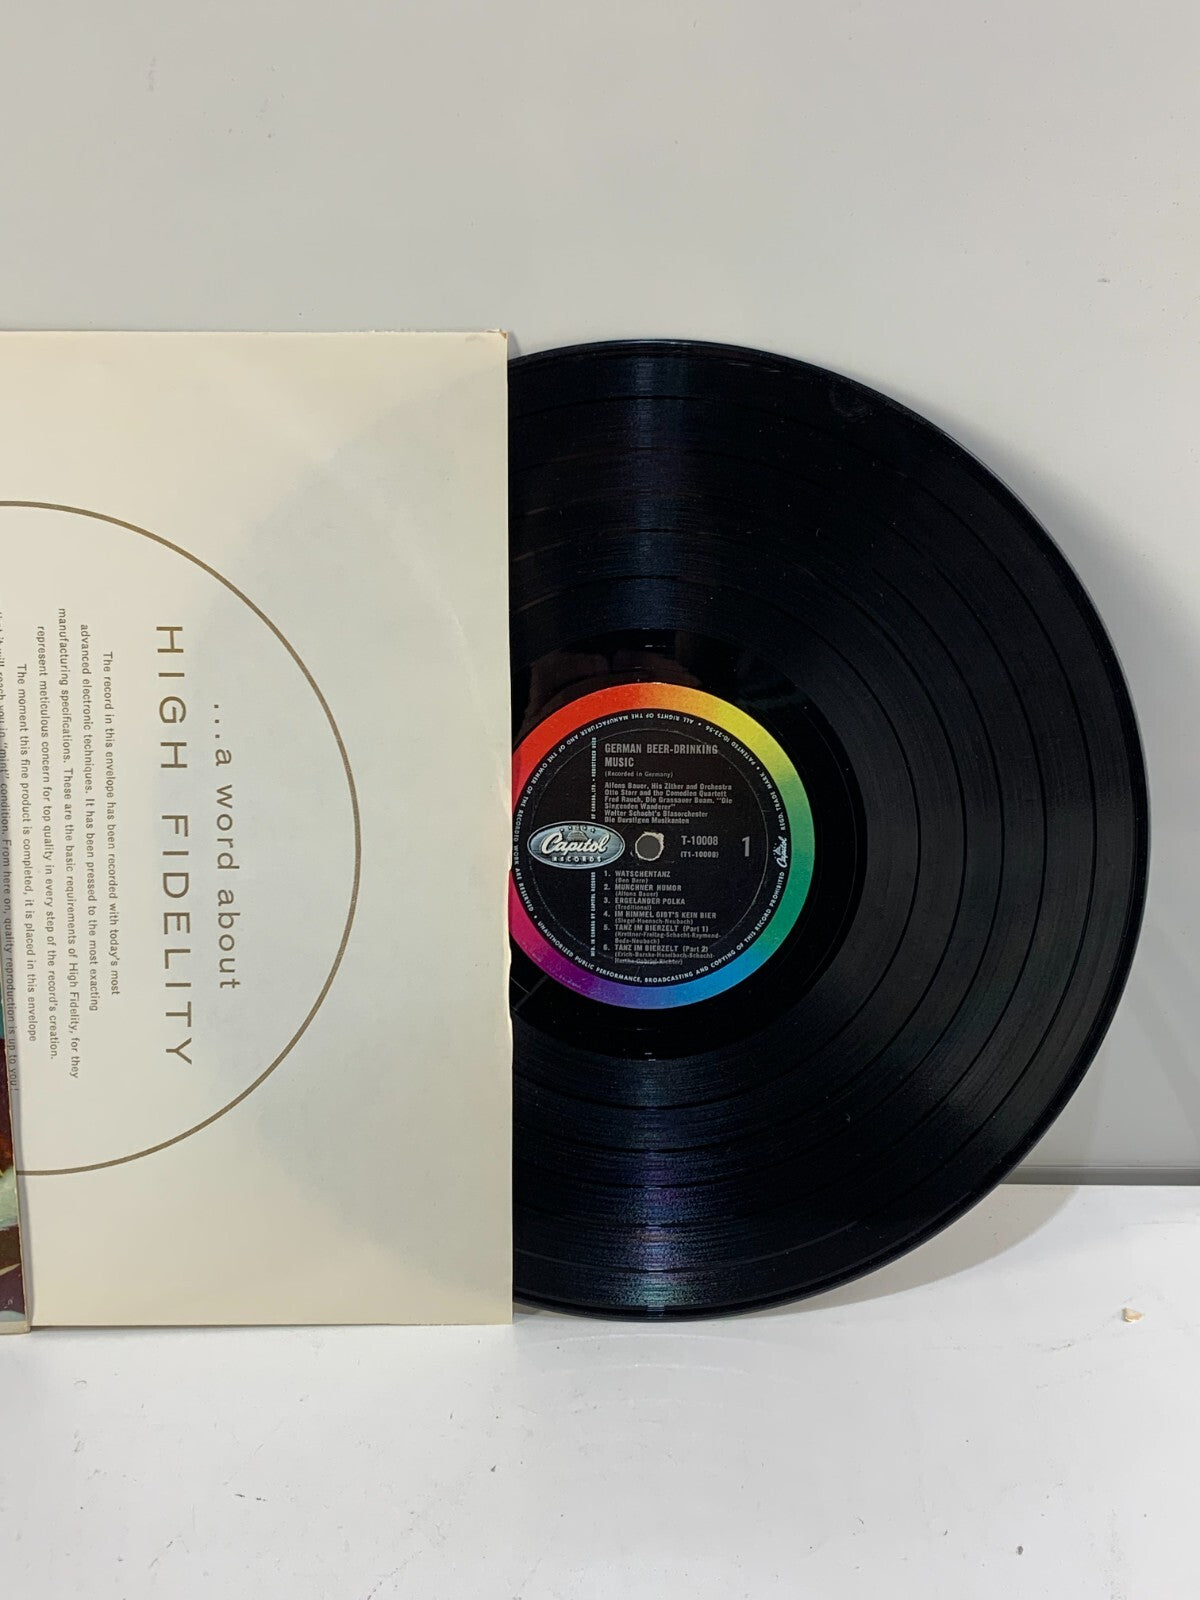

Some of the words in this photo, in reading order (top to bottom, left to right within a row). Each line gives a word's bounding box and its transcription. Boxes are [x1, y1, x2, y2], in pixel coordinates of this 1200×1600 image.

[35, 626, 48, 676] represent
[58, 608, 71, 686] manufacturing
[80, 624, 92, 675] advanced
[17, 663, 27, 685] The
[103, 651, 114, 672] The
[82, 678, 94, 731] electronic
[103, 676, 115, 710] record
[156, 626, 188, 769] HIGH
[18, 689, 29, 732] moment
[39, 680, 51, 738] meticulous
[104, 714, 115, 724] in
[59, 689, 73, 763] specifications.
[105, 728, 115, 748] this
[213, 704, 232, 767] ...a
[19, 735, 31, 756] this
[604, 743, 642, 754] GERMAN
[646, 743, 719, 755] BEER-DRINKING
[20, 758, 31, 779] fine
[41, 741, 50, 783] concern
[83, 734, 95, 794] techniques.
[104, 751, 116, 798] envelope
[604, 757, 635, 767] MUSIC
[63, 767, 74, 800] These
[644, 771, 674, 779] Germany)
[699, 783, 732, 791] Orchestra
[19, 782, 32, 822] product
[42, 786, 53, 802] for
[85, 798, 95, 807] It
[0, 783, 11, 835] condition.
[42, 805, 52, 822] top
[64, 803, 72, 820] are
[85, 810, 96, 829] has
[106, 802, 117, 820] has
[22, 826, 33, 835] is
[64, 824, 74, 841] the
[107, 824, 117, 849] been
[216, 784, 240, 869] word
[2, 840, 12, 867] From
[42, 825, 54, 861] quality
[86, 832, 96, 858] been
[541, 831, 610, 856] Capitol
[681, 835, 719, 846] T-10008
[741, 836, 750, 857] 1
[776, 835, 789, 868] Capitol
[22, 838, 34, 895] completed,
[45, 865, 55, 875] in
[65, 845, 76, 872] basic
[3, 871, 12, 893] here
[85, 862, 98, 902] pressed
[108, 853, 119, 899] recorded
[614, 870, 671, 878] WATSCHENTANZ
[24, 899, 35, 907] it
[43, 878, 53, 908] every
[3, 898, 11, 914] on,
[25, 910, 35, 919] is
[65, 876, 77, 945] requirements
[87, 905, 97, 916] to
[109, 902, 119, 925] with
[44, 911, 56, 933] step
[88, 919, 98, 936] the
[4, 918, 14, 952] quality
[24, 923, 36, 956] placed
[46, 936, 57, 946] of
[108, 929, 120, 966] today's
[161, 815, 192, 1065] FIDELITY
[217, 889, 241, 989] about
[27, 960, 37, 970] in
[47, 950, 57, 967] the
[68, 948, 78, 958] of
[89, 940, 99, 965] most
[27, 973, 37, 993] this
[67, 962, 79, 988] High
[110, 970, 121, 995] most
[5, 957, 16, 1022] reproduction
[47, 970, 58, 1012] record's
[89, 968, 100, 1011] exacting
[27, 996, 38, 1042] envelope
[68, 991, 80, 1034] Fidelity,
[8, 1026, 17, 1035] is
[49, 1015, 60, 1059] creation.
[7, 1038, 16, 1051] up
[70, 1037, 80, 1052] for
[9, 1055, 17, 1065] to
[69, 1056, 81, 1078] they
